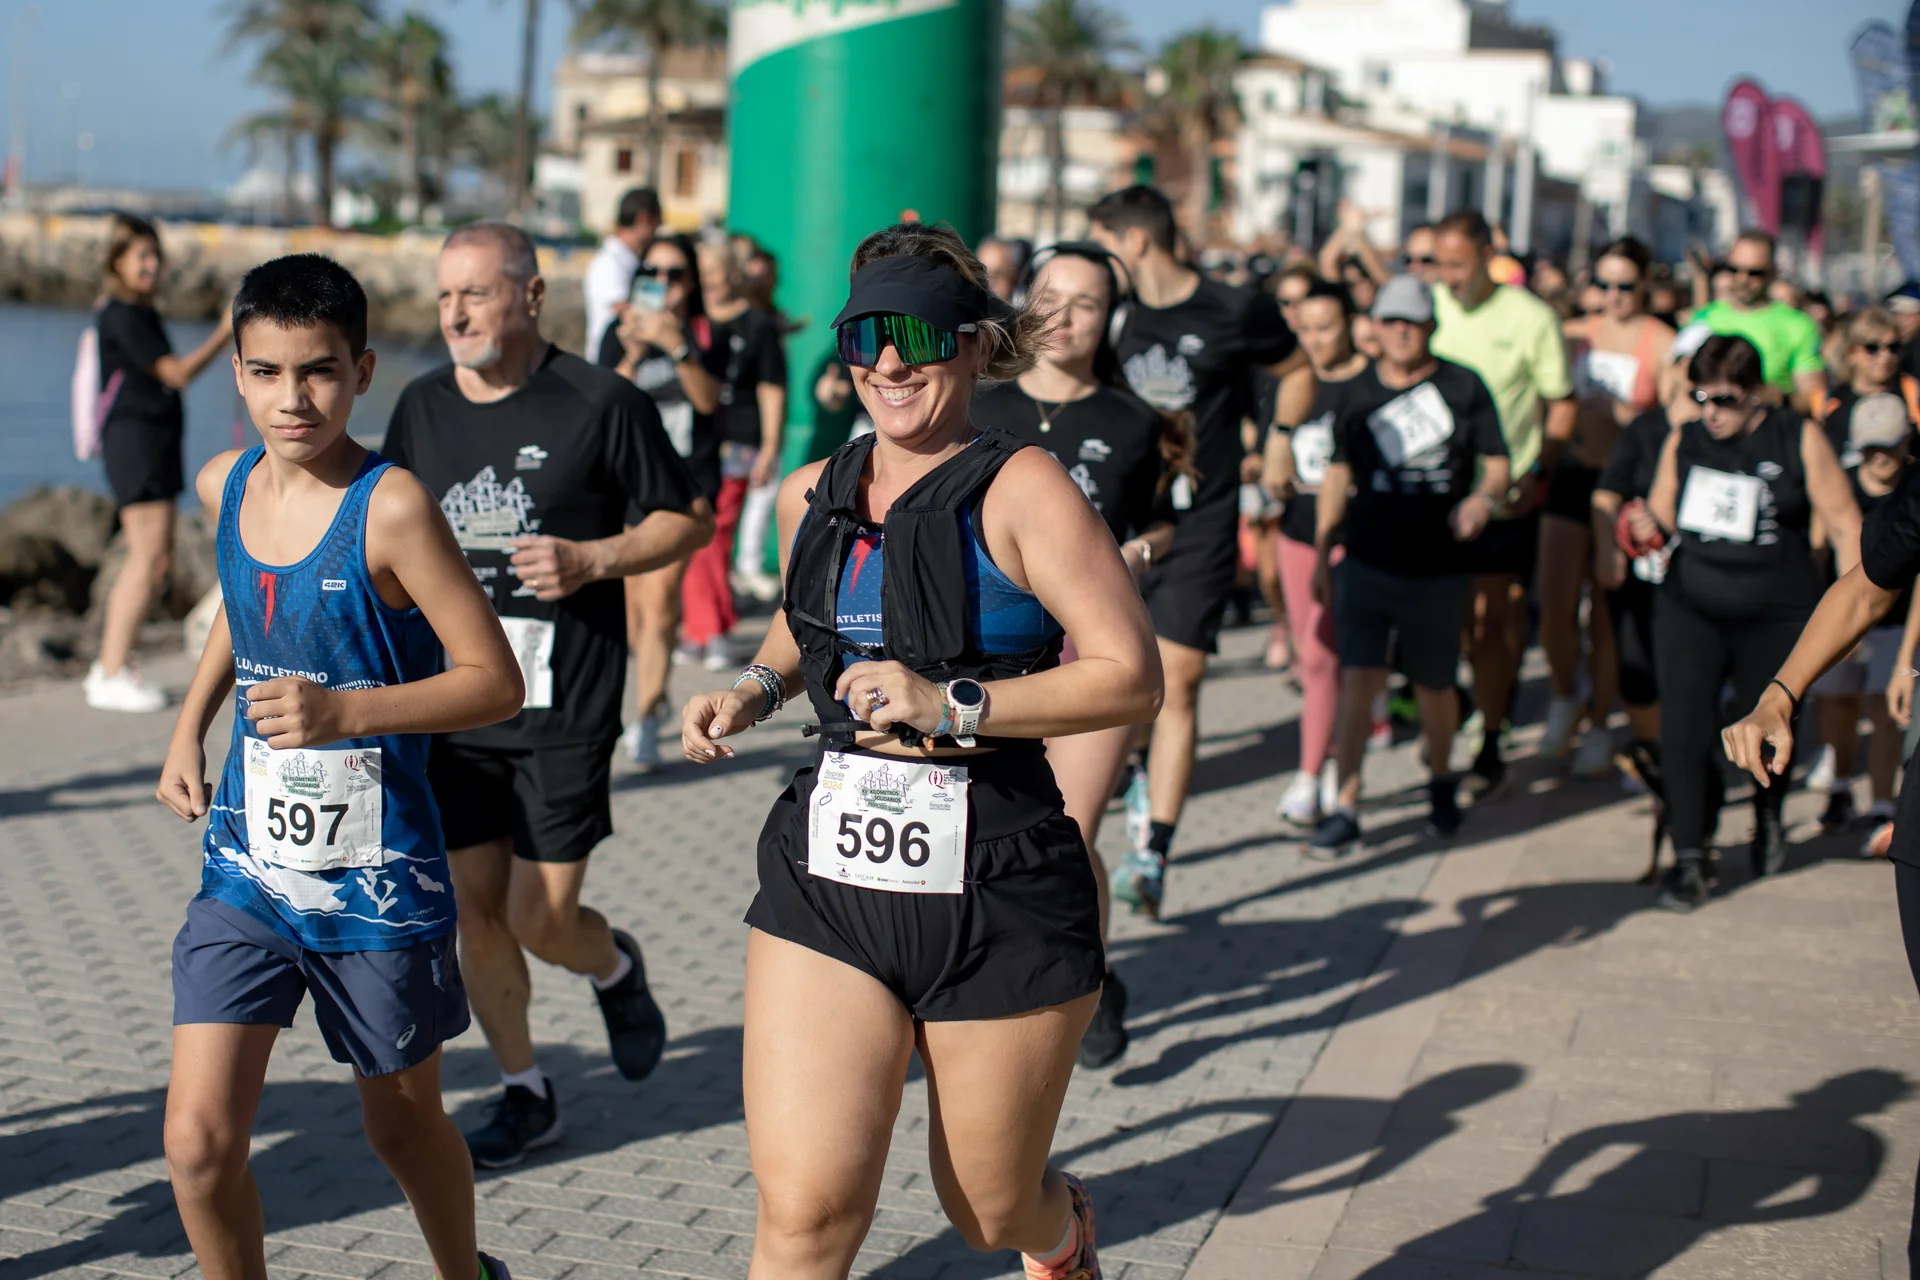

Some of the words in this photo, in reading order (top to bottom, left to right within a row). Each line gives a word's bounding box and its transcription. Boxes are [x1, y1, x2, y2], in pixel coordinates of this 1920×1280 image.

[324, 581, 345, 589] 42K
[253, 663, 329, 683] ATLETISMO
[822, 779, 843, 791] 2024
[874, 795, 902, 803] SOLIDARIOS
[268, 798, 349, 846] 597
[836, 812, 931, 868] 596
